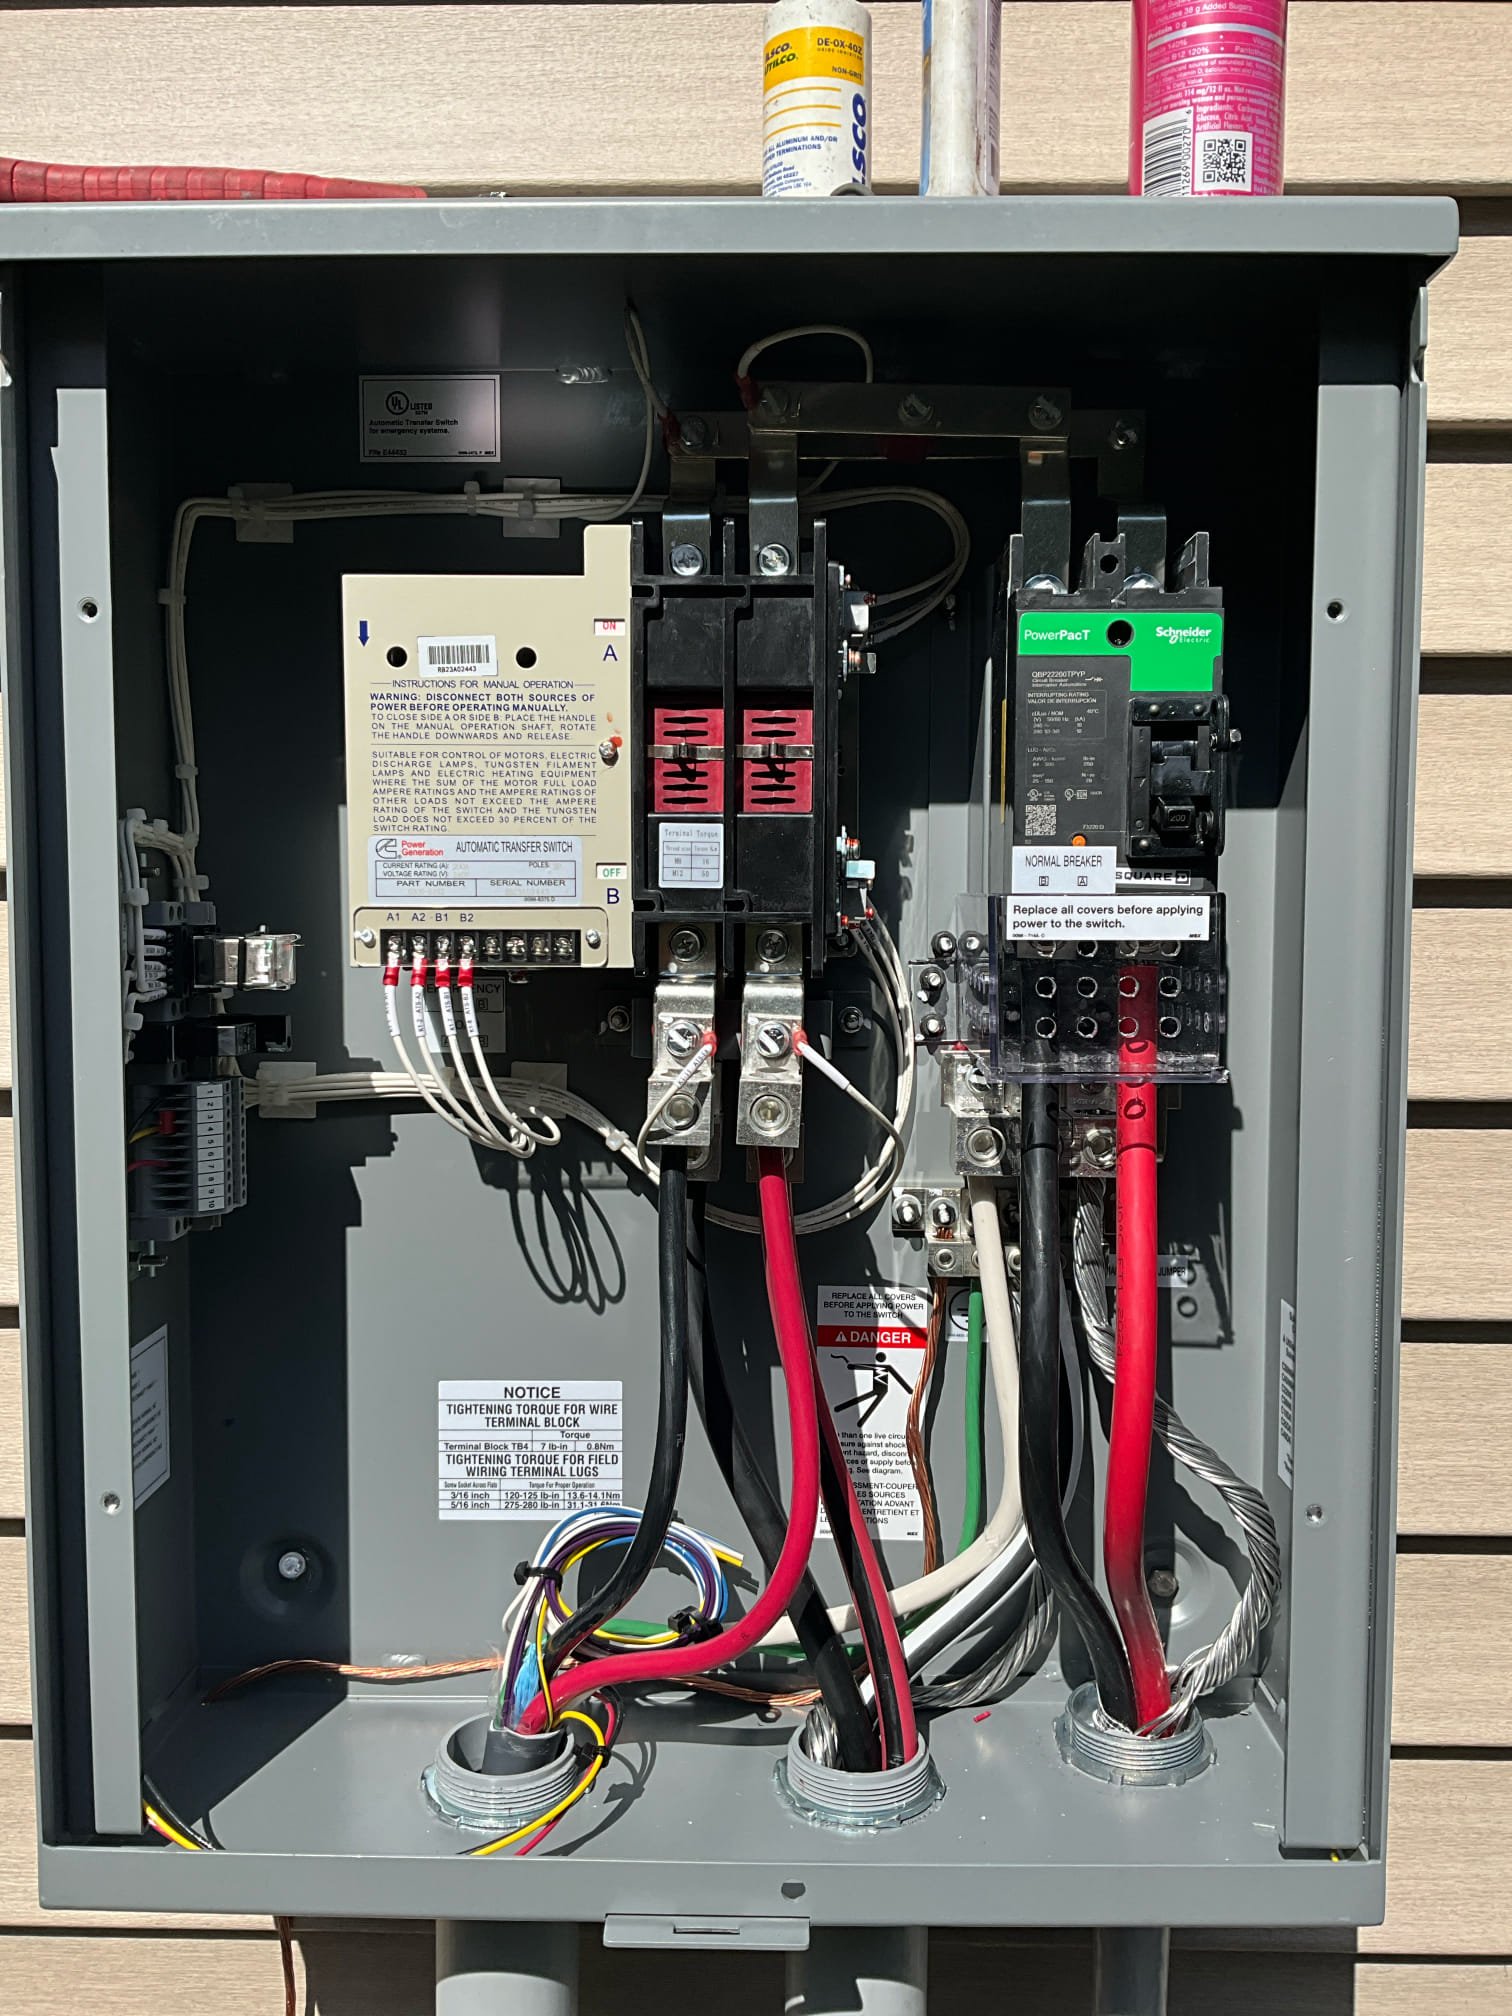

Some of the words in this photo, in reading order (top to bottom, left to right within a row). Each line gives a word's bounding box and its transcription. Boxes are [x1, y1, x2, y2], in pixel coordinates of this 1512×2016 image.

[1203, 2, 1226, 10] Added
[776, 136, 808, 147] ALUMINUM
[776, 144, 821, 156] TERMINATIONS
[602, 622, 616, 631] ON
[1024, 630, 1090, 640] PowerPacT
[1156, 626, 1211, 640] Schneider
[603, 644, 618, 661] A
[392, 680, 456, 688] INSTRUCTIONS
[460, 680, 478, 688] FOR
[483, 680, 520, 689] MANUAL
[523, 680, 574, 689] OPERATION
[370, 693, 420, 701] WARNING:
[426, 693, 491, 702] DISCONNECT
[496, 693, 524, 702] BOTH
[528, 694, 577, 702] SOURCES
[582, 694, 594, 702] OF
[370, 703, 407, 711] POWER
[410, 703, 450, 712] BEFORE
[452, 703, 510, 712] OPERATING
[512, 704, 568, 712] MANUALLY.
[372, 760, 432, 768] DISCHARGE
[485, 760, 539, 768] TUNGSTEN
[546, 761, 596, 769] FILAMENT
[373, 824, 410, 832] SWITCH
[402, 848, 444, 856] Generation
[456, 841, 499, 853] AUTOMATIC
[500, 841, 542, 853] TRANSFER
[543, 841, 572, 853] SWITCH
[1026, 855, 1061, 868] NORMAL
[1064, 855, 1102, 867] BREAKER
[602, 868, 621, 877] OFF
[1116, 872, 1172, 880] SQUARE
[607, 889, 620, 904] B
[1013, 905, 1058, 916] Replace
[1061, 905, 1074, 914] all
[1117, 905, 1153, 914] before
[1156, 905, 1203, 916] applying
[386, 912, 400, 921] A1
[412, 912, 426, 922] A2
[435, 912, 448, 922] B1
[460, 913, 474, 922] B2
[1013, 920, 1048, 930] power
[1050, 920, 1062, 928] to
[1065, 919, 1082, 928] the
[1086, 919, 1125, 928] switch.
[1158, 1267, 1186, 1276] JUMPER
[850, 1331, 911, 1343] DANGER
[504, 1386, 560, 1399] NOTICE
[446, 1404, 512, 1415] TIGHTENING
[516, 1404, 560, 1415] TORQUE
[564, 1404, 586, 1415] FOR
[589, 1404, 618, 1415] WIRE
[485, 1417, 540, 1428] TERMINAL
[544, 1416, 580, 1428] BLOCK
[560, 1430, 590, 1440] Torque
[444, 1442, 481, 1450] Terminal
[484, 1442, 508, 1450] Block
[511, 1442, 528, 1450] TB4
[541, 1442, 546, 1450] 7
[586, 1442, 614, 1450] 0.8Nm
[446, 1454, 511, 1465] TIGHTENING
[515, 1454, 559, 1465] TORQUE
[563, 1454, 584, 1465] FOR
[588, 1454, 618, 1465] FIELD
[466, 1466, 507, 1477] WIRING
[510, 1466, 566, 1477] TERMINAL
[570, 1466, 599, 1477] LUGS
[529, 1481, 545, 1490] Torque
[555, 1481, 570, 1490] Proper
[572, 1481, 595, 1490] Operation
[451, 1501, 469, 1509] 5/16
[470, 1501, 490, 1510] inch
[504, 1501, 538, 1510] 275-280
[540, 1501, 560, 1510] lb-in
